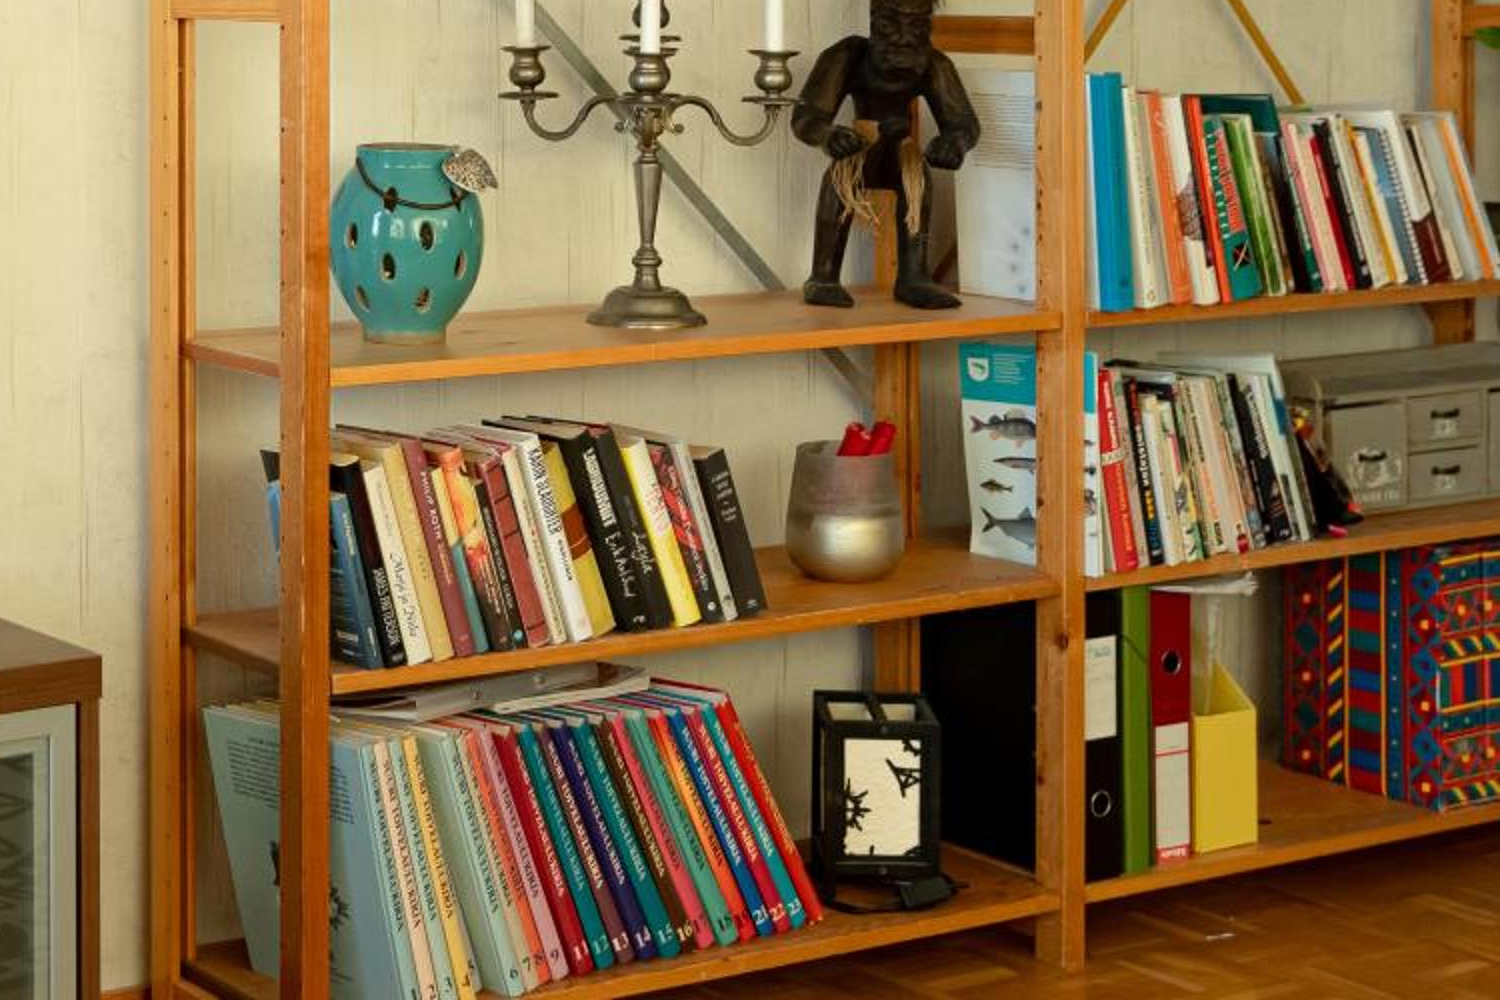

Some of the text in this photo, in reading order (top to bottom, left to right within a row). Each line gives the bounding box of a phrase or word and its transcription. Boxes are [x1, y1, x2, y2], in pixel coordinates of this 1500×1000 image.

[420, 471, 443, 540] PHILIP ROTH
[536, 480, 560, 536] SLAUGHTER
[389, 806, 421, 929] TOIVELAULUKIRJA
[769, 902, 786, 923] 22
[787, 897, 802, 917] 23
[612, 931, 630, 952] 13
[635, 928, 652, 949] 14
[657, 923, 675, 945] 15
[676, 920, 694, 943] 16
[572, 942, 589, 961] 11
[593, 935, 610, 956] 12
